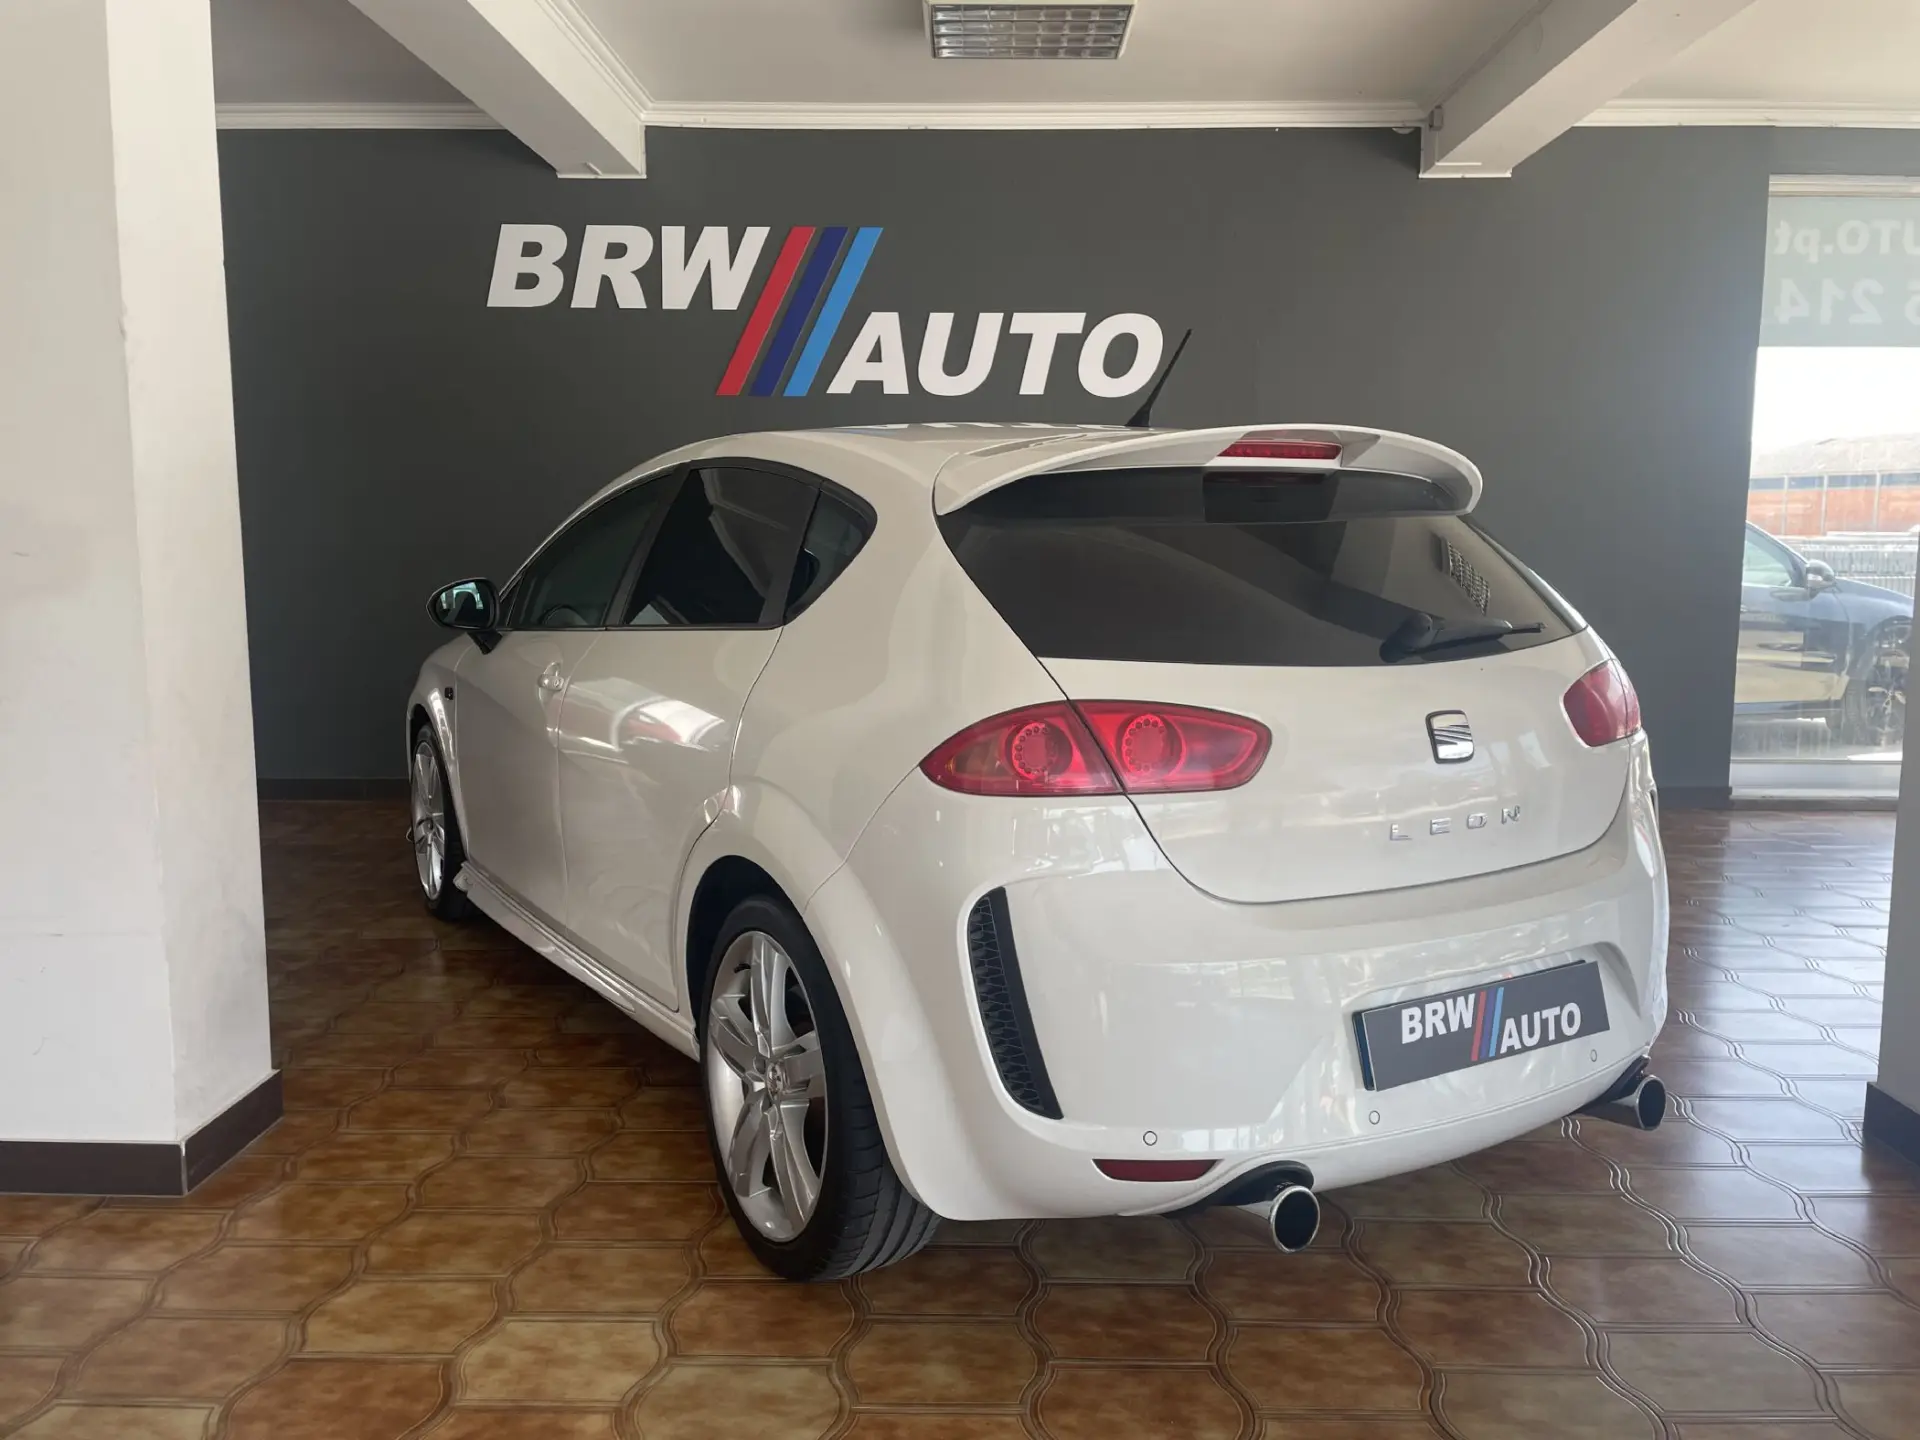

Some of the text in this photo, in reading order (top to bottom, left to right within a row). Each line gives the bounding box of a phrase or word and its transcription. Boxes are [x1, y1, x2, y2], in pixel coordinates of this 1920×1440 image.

[486, 223, 771, 311] BRW
[826, 311, 1165, 398] AUTO
[1389, 804, 1521, 841] LEON
[1401, 993, 1476, 1044] BRW
[1500, 1002, 1582, 1054] AUTO
